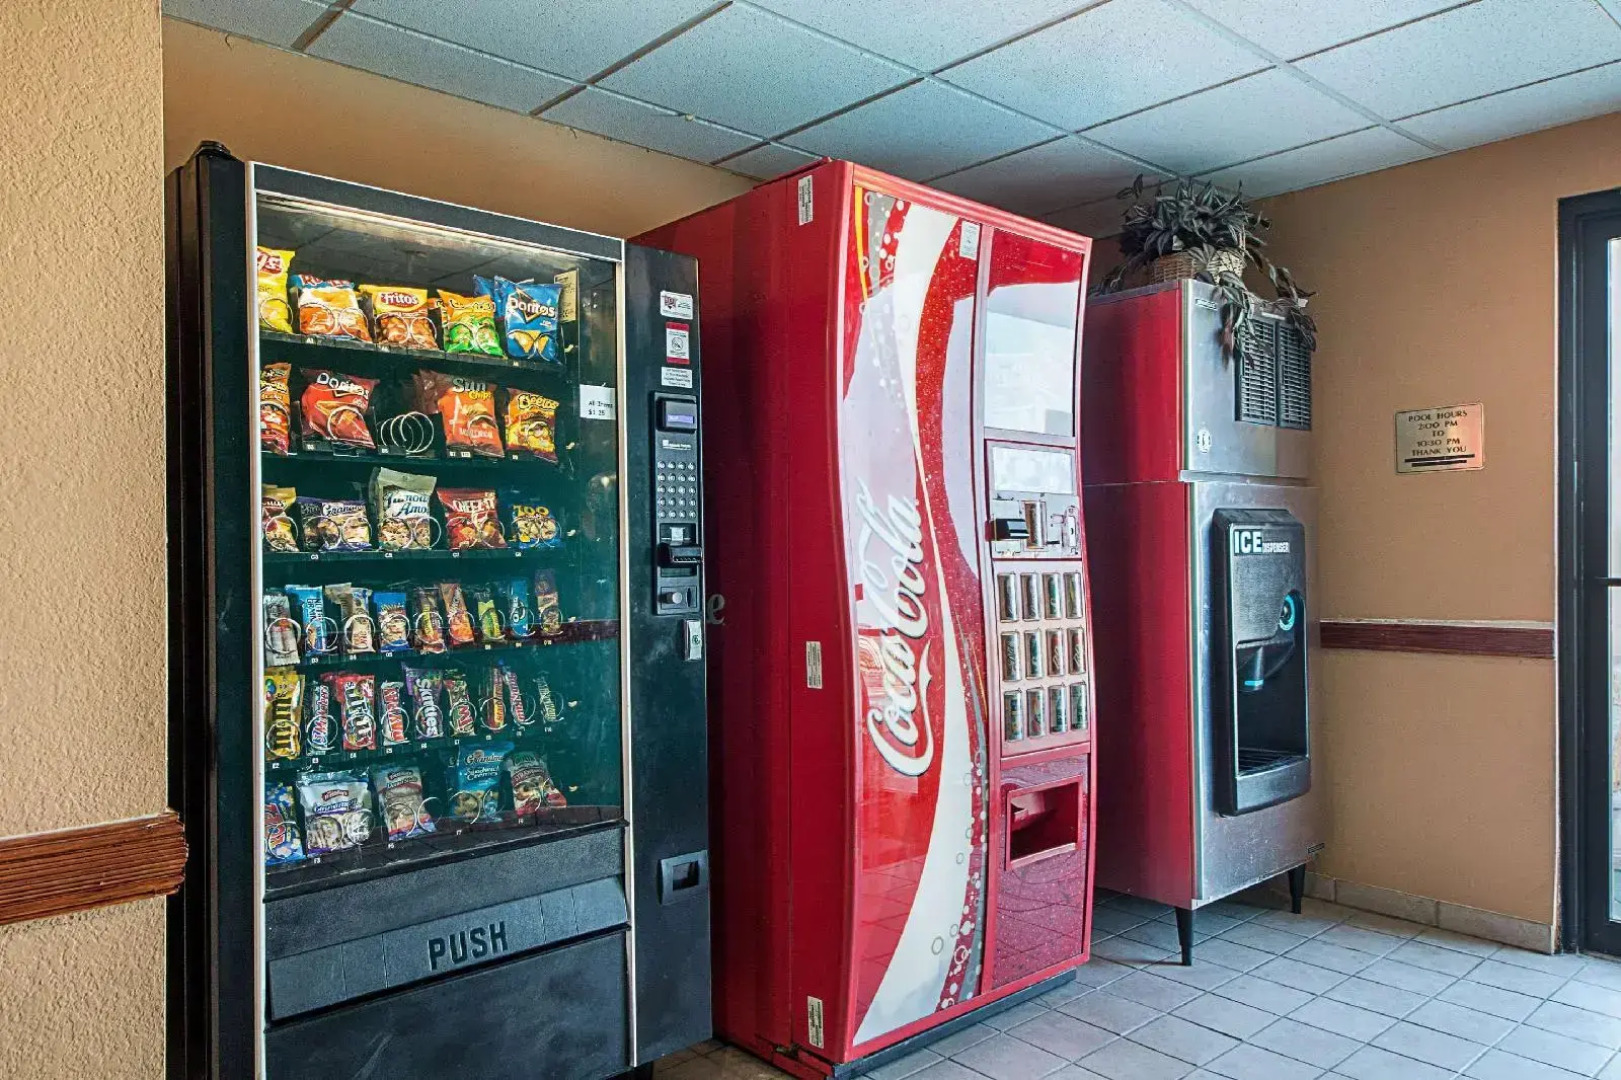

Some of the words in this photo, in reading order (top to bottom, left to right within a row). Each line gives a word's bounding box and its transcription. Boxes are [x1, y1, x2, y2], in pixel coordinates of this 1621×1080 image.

[509, 297, 556, 318] Doritos
[317, 372, 369, 400] Doritos
[452, 378, 486, 393] Sun
[1408, 414, 1431, 422] POOL
[1437, 410, 1467, 419] HOURS
[1418, 421, 1440, 430] 2:00
[1412, 448, 1441, 456] THANK
[1447, 446, 1467, 454] YOU
[1417, 439, 1442, 447] 10:30
[1446, 437, 1460, 445] PM
[1234, 531, 1263, 554] ICE
[414, 678, 438, 736] Skittles
[428, 920, 509, 971] PUSH
